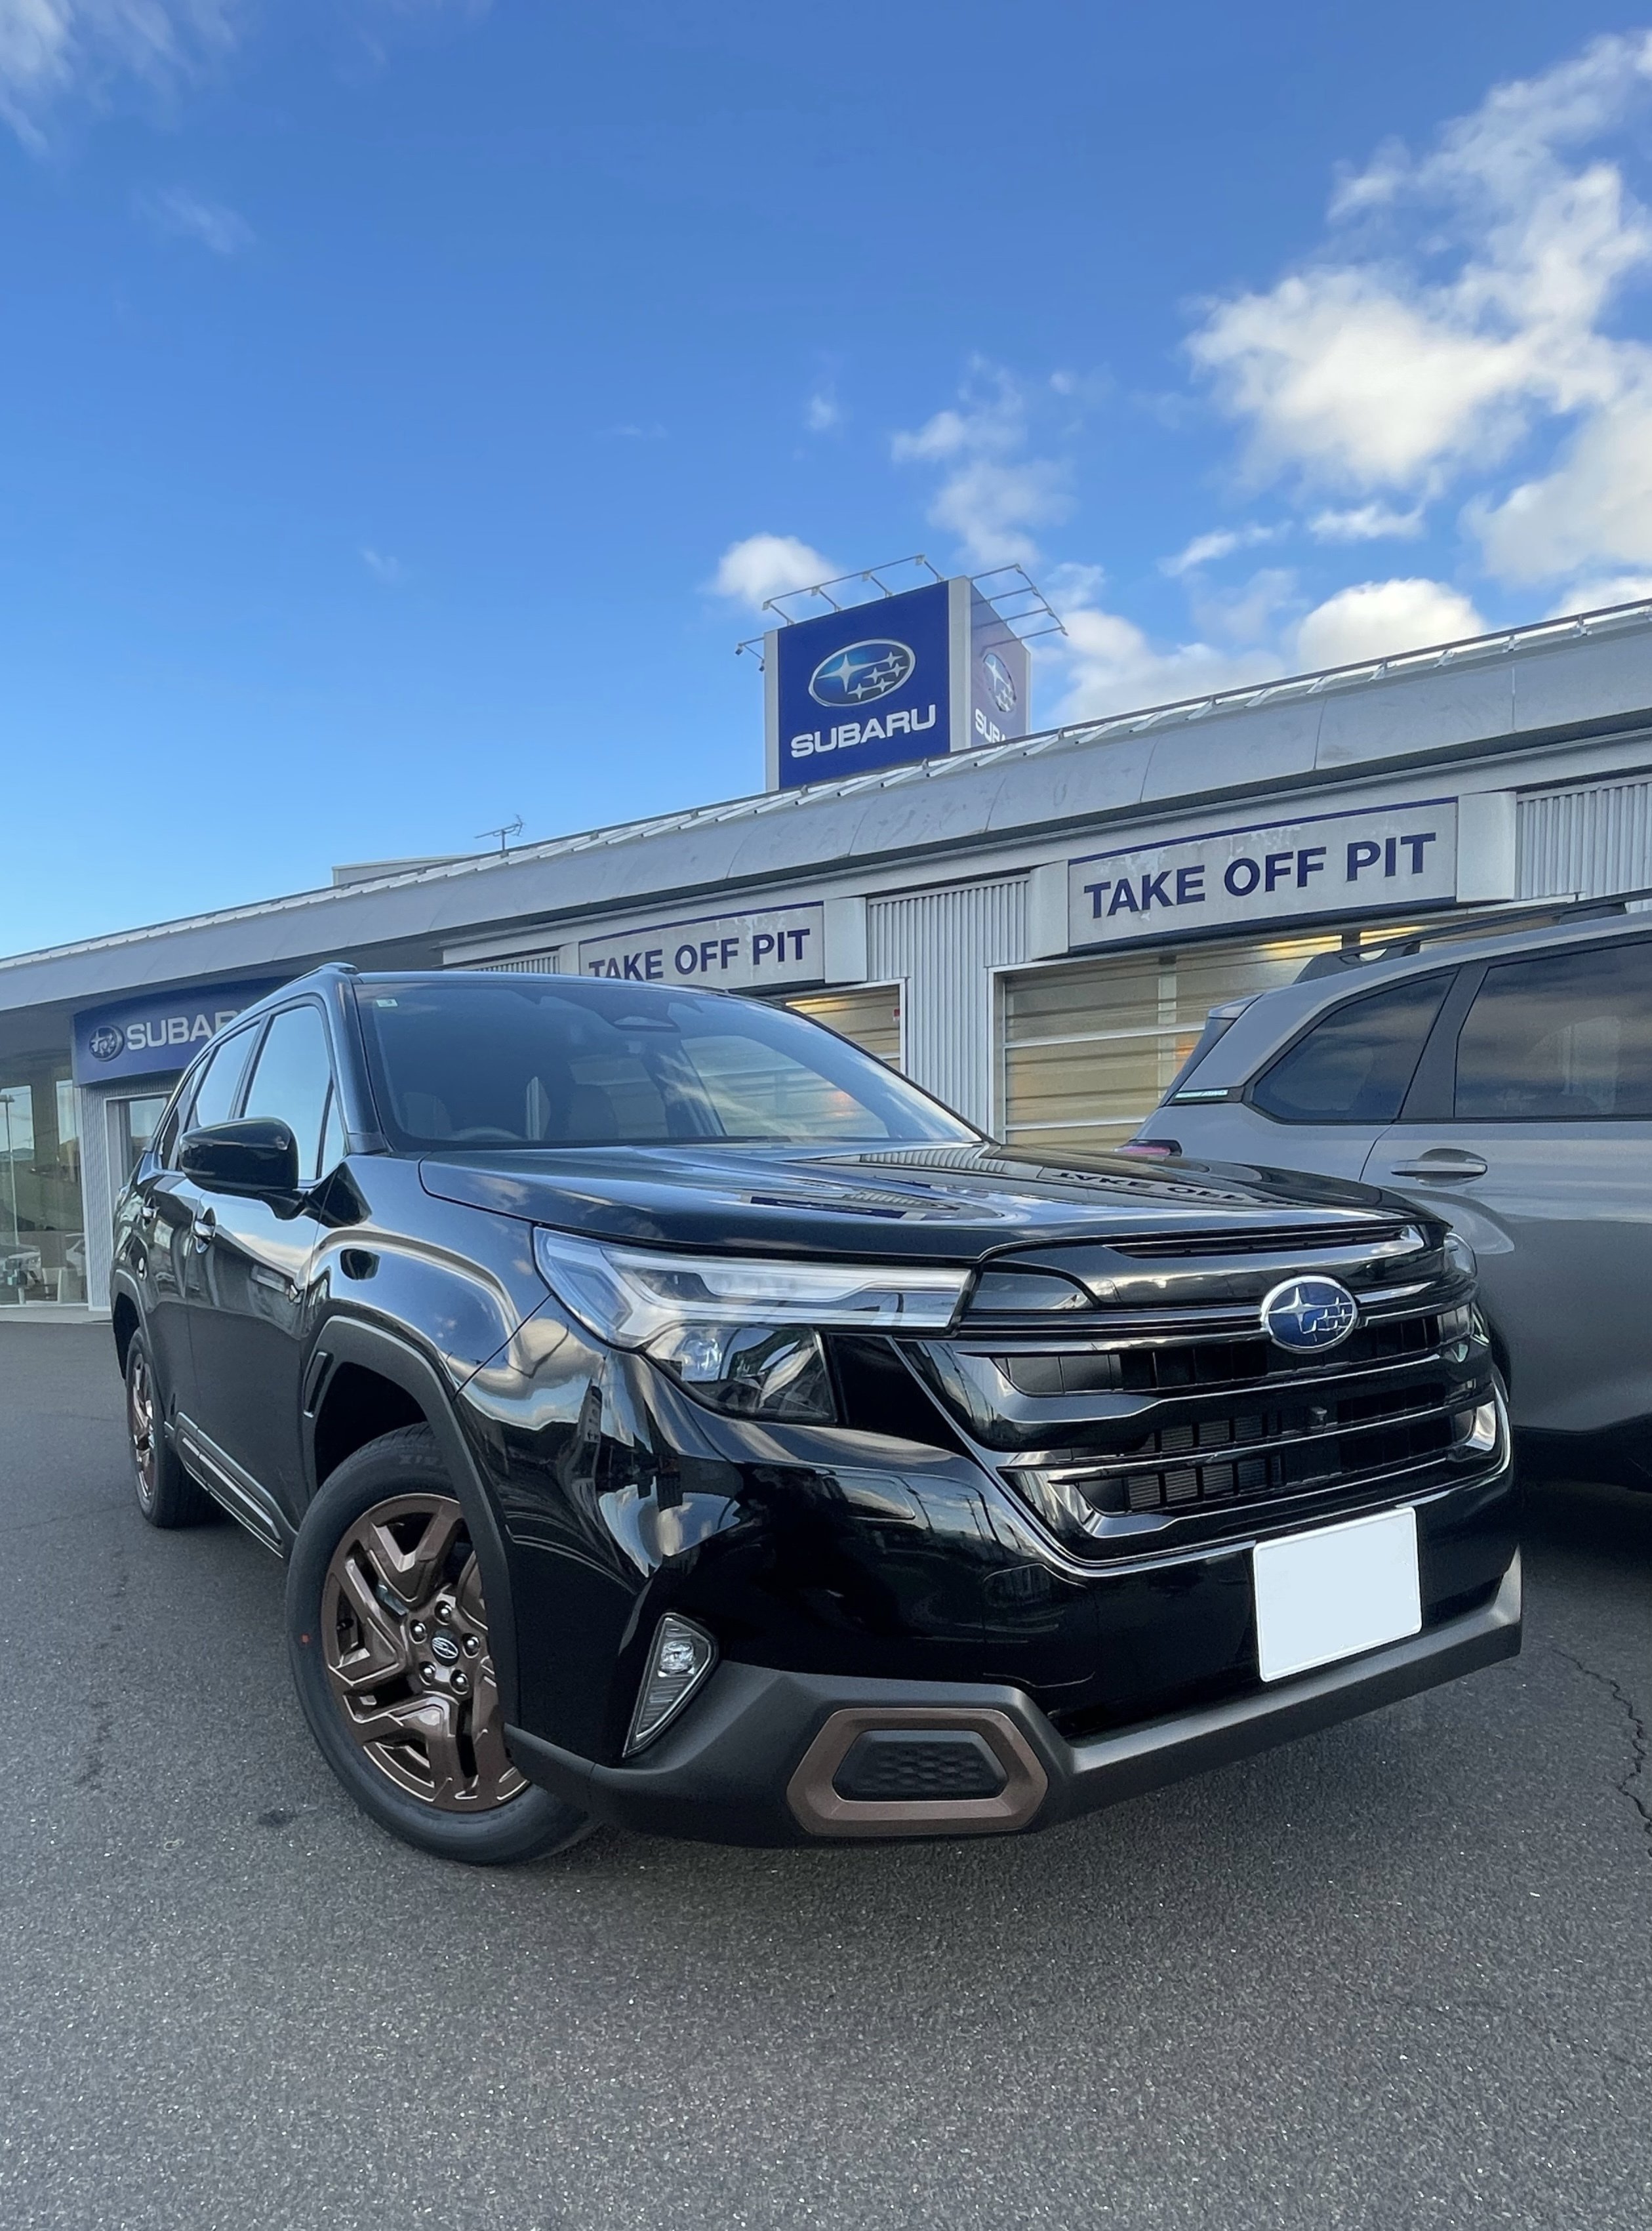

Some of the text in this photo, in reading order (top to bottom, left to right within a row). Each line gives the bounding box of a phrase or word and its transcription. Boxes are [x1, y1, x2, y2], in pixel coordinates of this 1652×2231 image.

[791, 704, 936, 758] SUBARU
[1083, 832, 1436, 918] TAKE OFF PIT
[588, 928, 811, 981] TAKE OFF PIT
